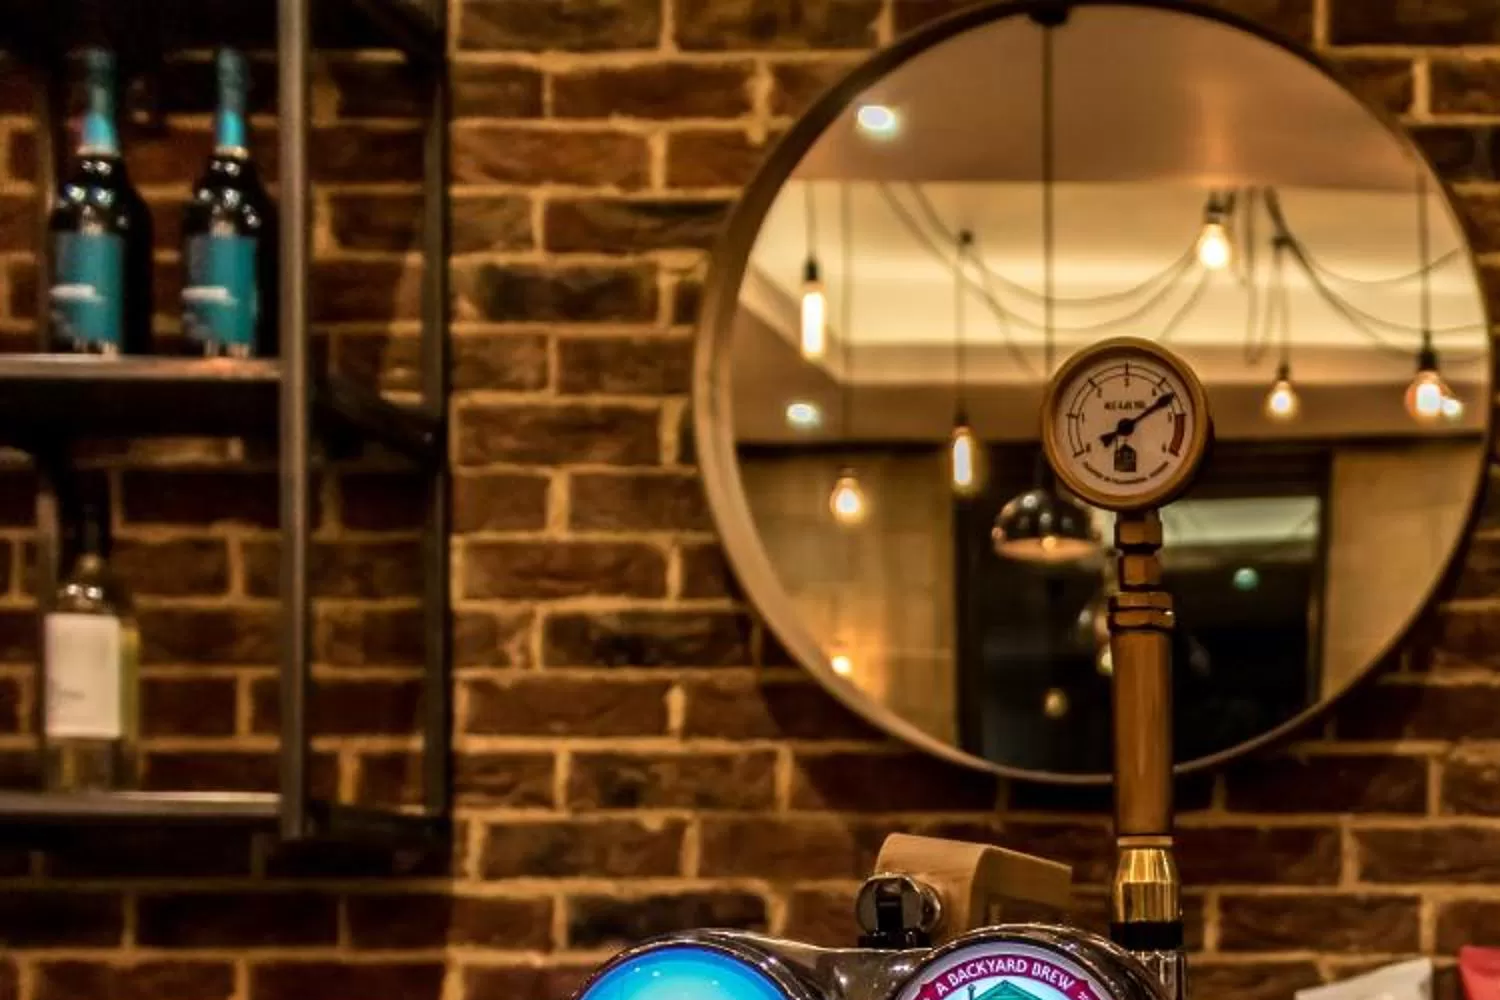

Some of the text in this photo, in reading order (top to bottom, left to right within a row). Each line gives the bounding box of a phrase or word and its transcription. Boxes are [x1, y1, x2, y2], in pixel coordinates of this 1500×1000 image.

[935, 958, 1075, 997] A BACKYARD BREW
